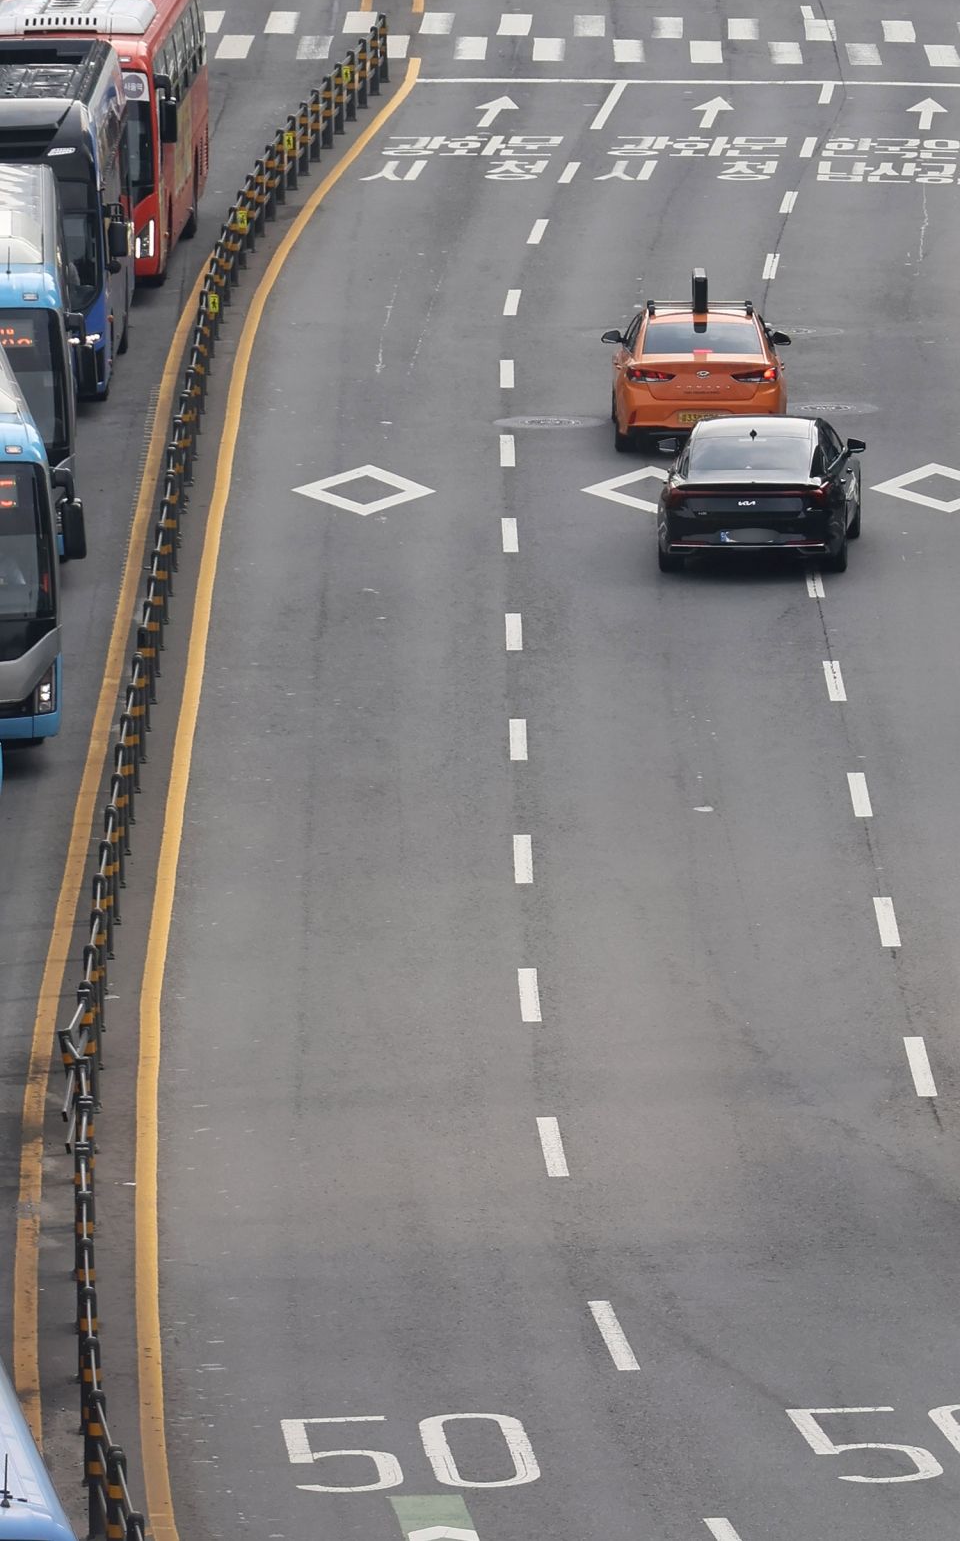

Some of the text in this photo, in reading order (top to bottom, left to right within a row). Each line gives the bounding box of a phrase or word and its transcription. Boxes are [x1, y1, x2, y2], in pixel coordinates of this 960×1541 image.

[381, 135, 564, 157] 광화문
[606, 135, 788, 157] 광화문
[280, 1413, 542, 1493] 50
